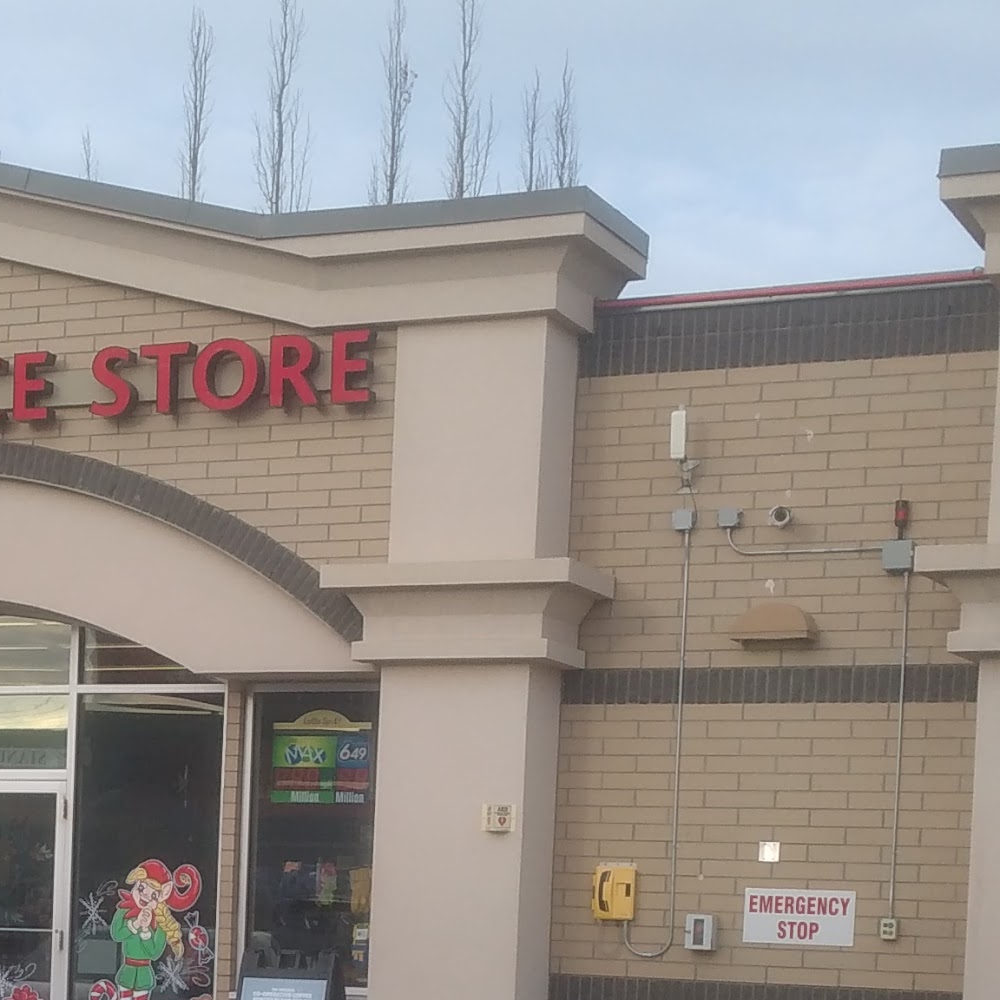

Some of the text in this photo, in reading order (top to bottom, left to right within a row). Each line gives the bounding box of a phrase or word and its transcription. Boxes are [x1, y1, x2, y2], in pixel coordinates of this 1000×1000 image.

[89, 329, 374, 418] STORE
[285, 744, 326, 764] MAX
[339, 743, 367, 760] 649
[290, 791, 320, 803] Million
[335, 791, 365, 803] Million
[748, 895, 851, 916] EMERGENCY
[777, 920, 819, 940] STOP
